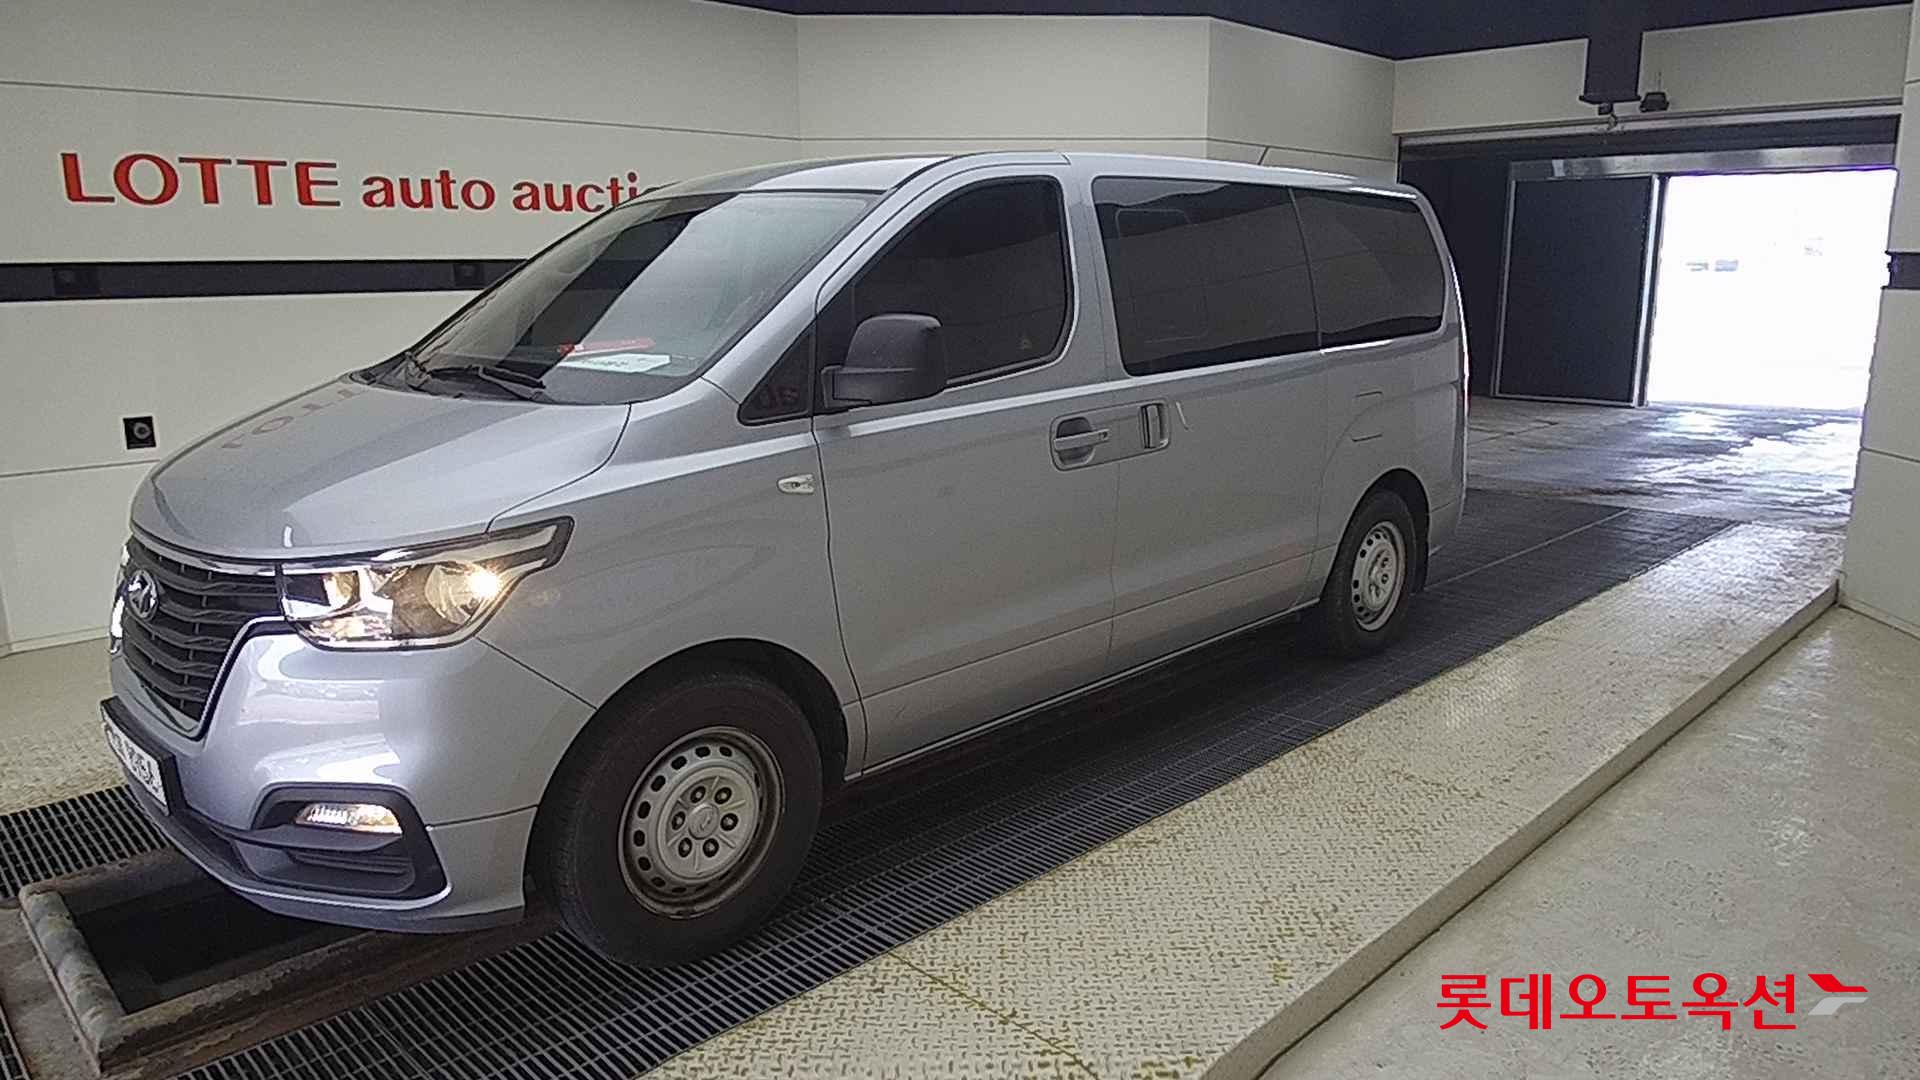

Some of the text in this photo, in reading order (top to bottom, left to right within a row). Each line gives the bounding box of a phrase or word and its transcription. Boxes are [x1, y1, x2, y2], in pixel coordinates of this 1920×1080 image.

[61, 152, 657, 213] LOTTE auto aucti
